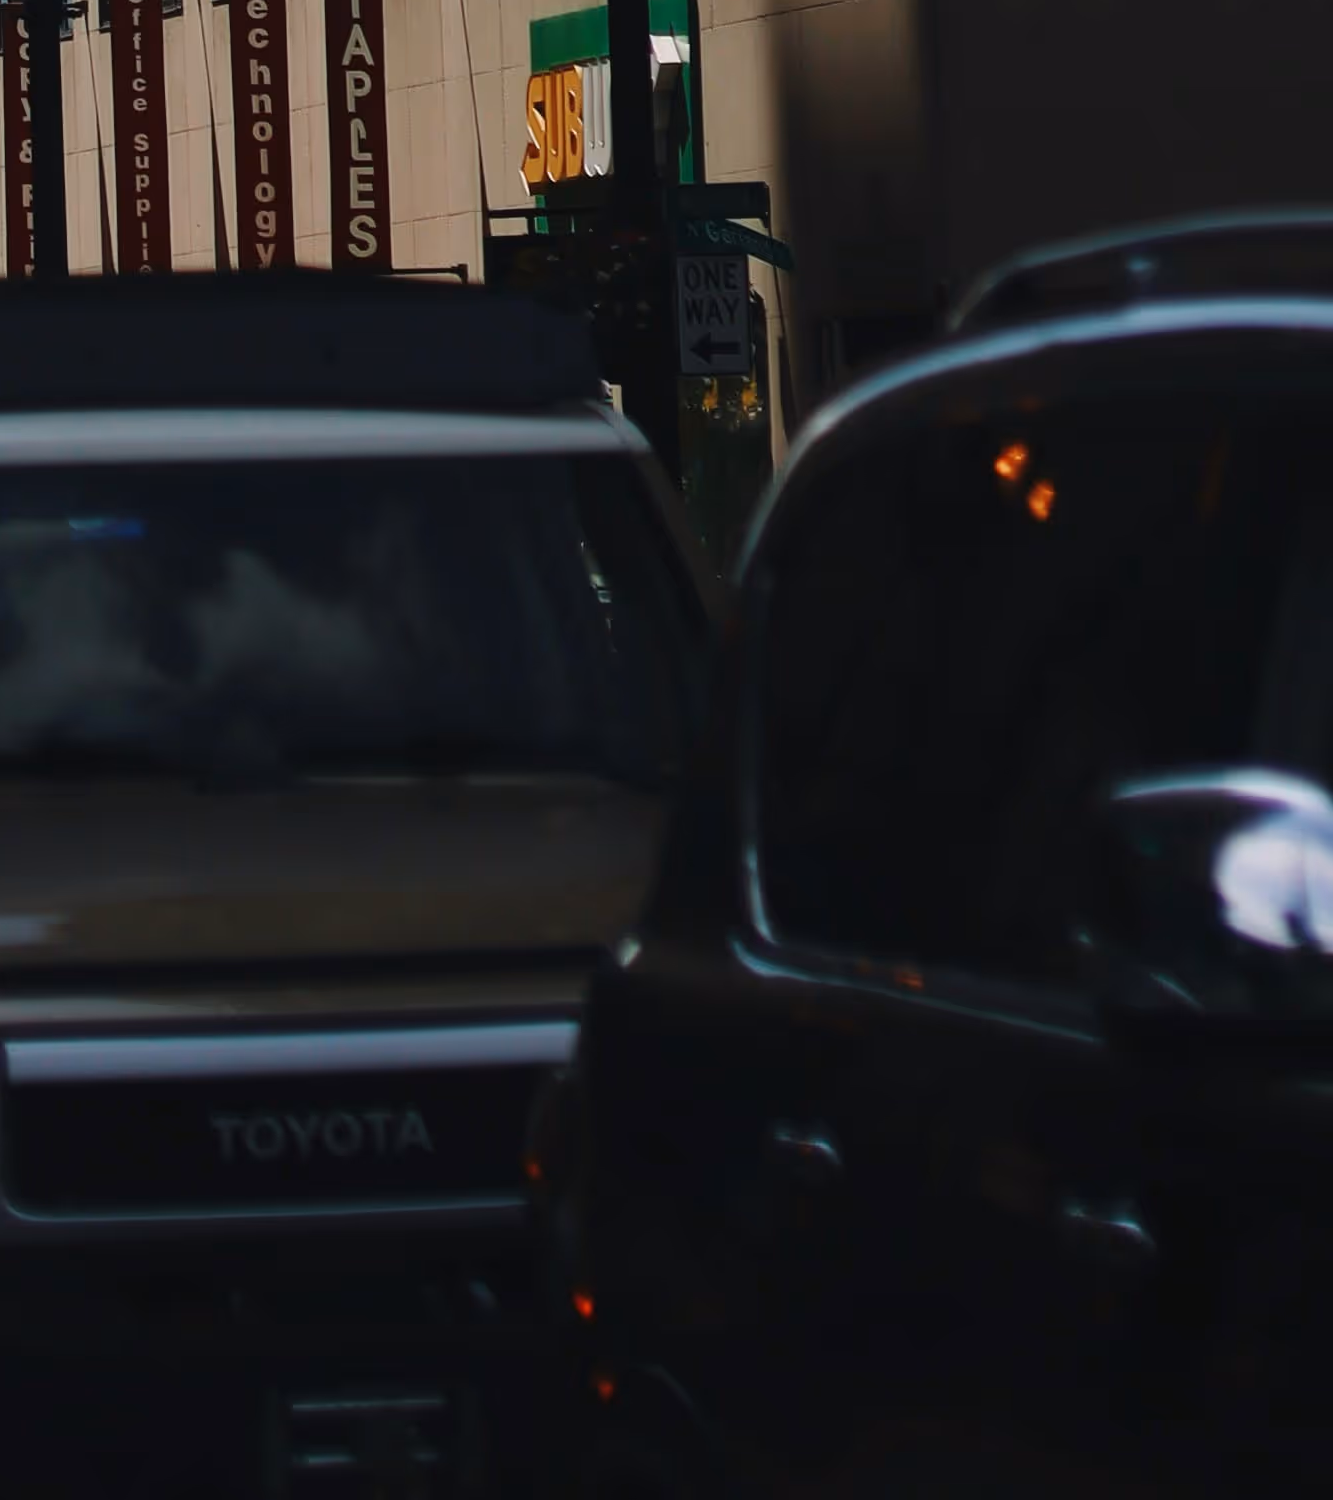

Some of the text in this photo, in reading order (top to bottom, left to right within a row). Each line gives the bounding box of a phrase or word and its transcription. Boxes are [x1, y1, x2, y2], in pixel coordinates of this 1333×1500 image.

[133, 132, 153, 276] Supplie
[684, 261, 738, 291] ONE
[684, 296, 740, 326] WAY
[210, 1104, 434, 1162] TOYOTA
